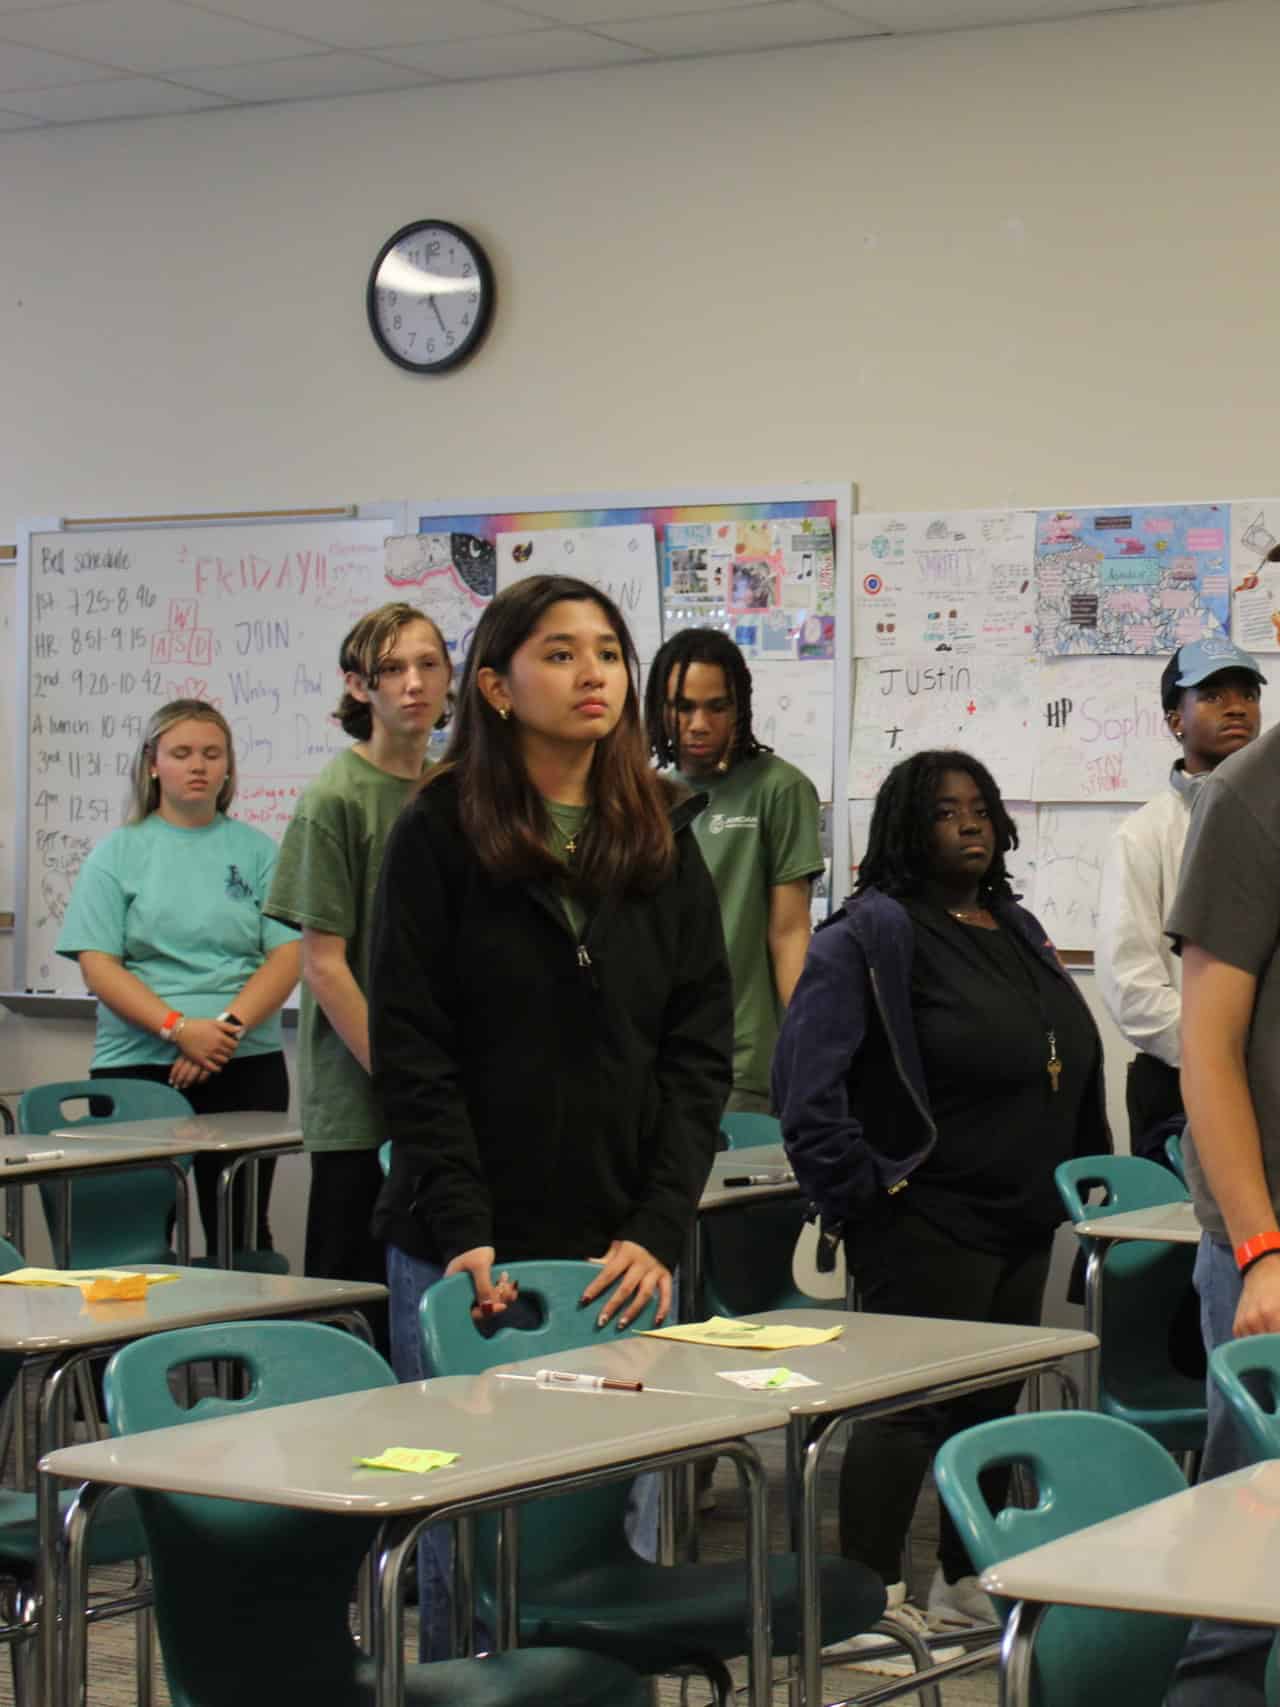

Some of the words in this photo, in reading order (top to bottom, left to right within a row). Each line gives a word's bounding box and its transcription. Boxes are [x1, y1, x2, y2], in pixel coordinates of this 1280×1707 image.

[425, 241, 441, 264] 12
[463, 264, 472, 278] 2
[387, 290, 398, 307] 9
[467, 292, 477, 304] 3
[393, 315, 403, 330] 8
[460, 312, 469, 326] 4
[408, 332, 417, 348] 7
[426, 337, 435, 353] 6
[446, 330, 455, 346] 5
[880, 665, 971, 696] Justin
[1043, 697, 1073, 730] HP
